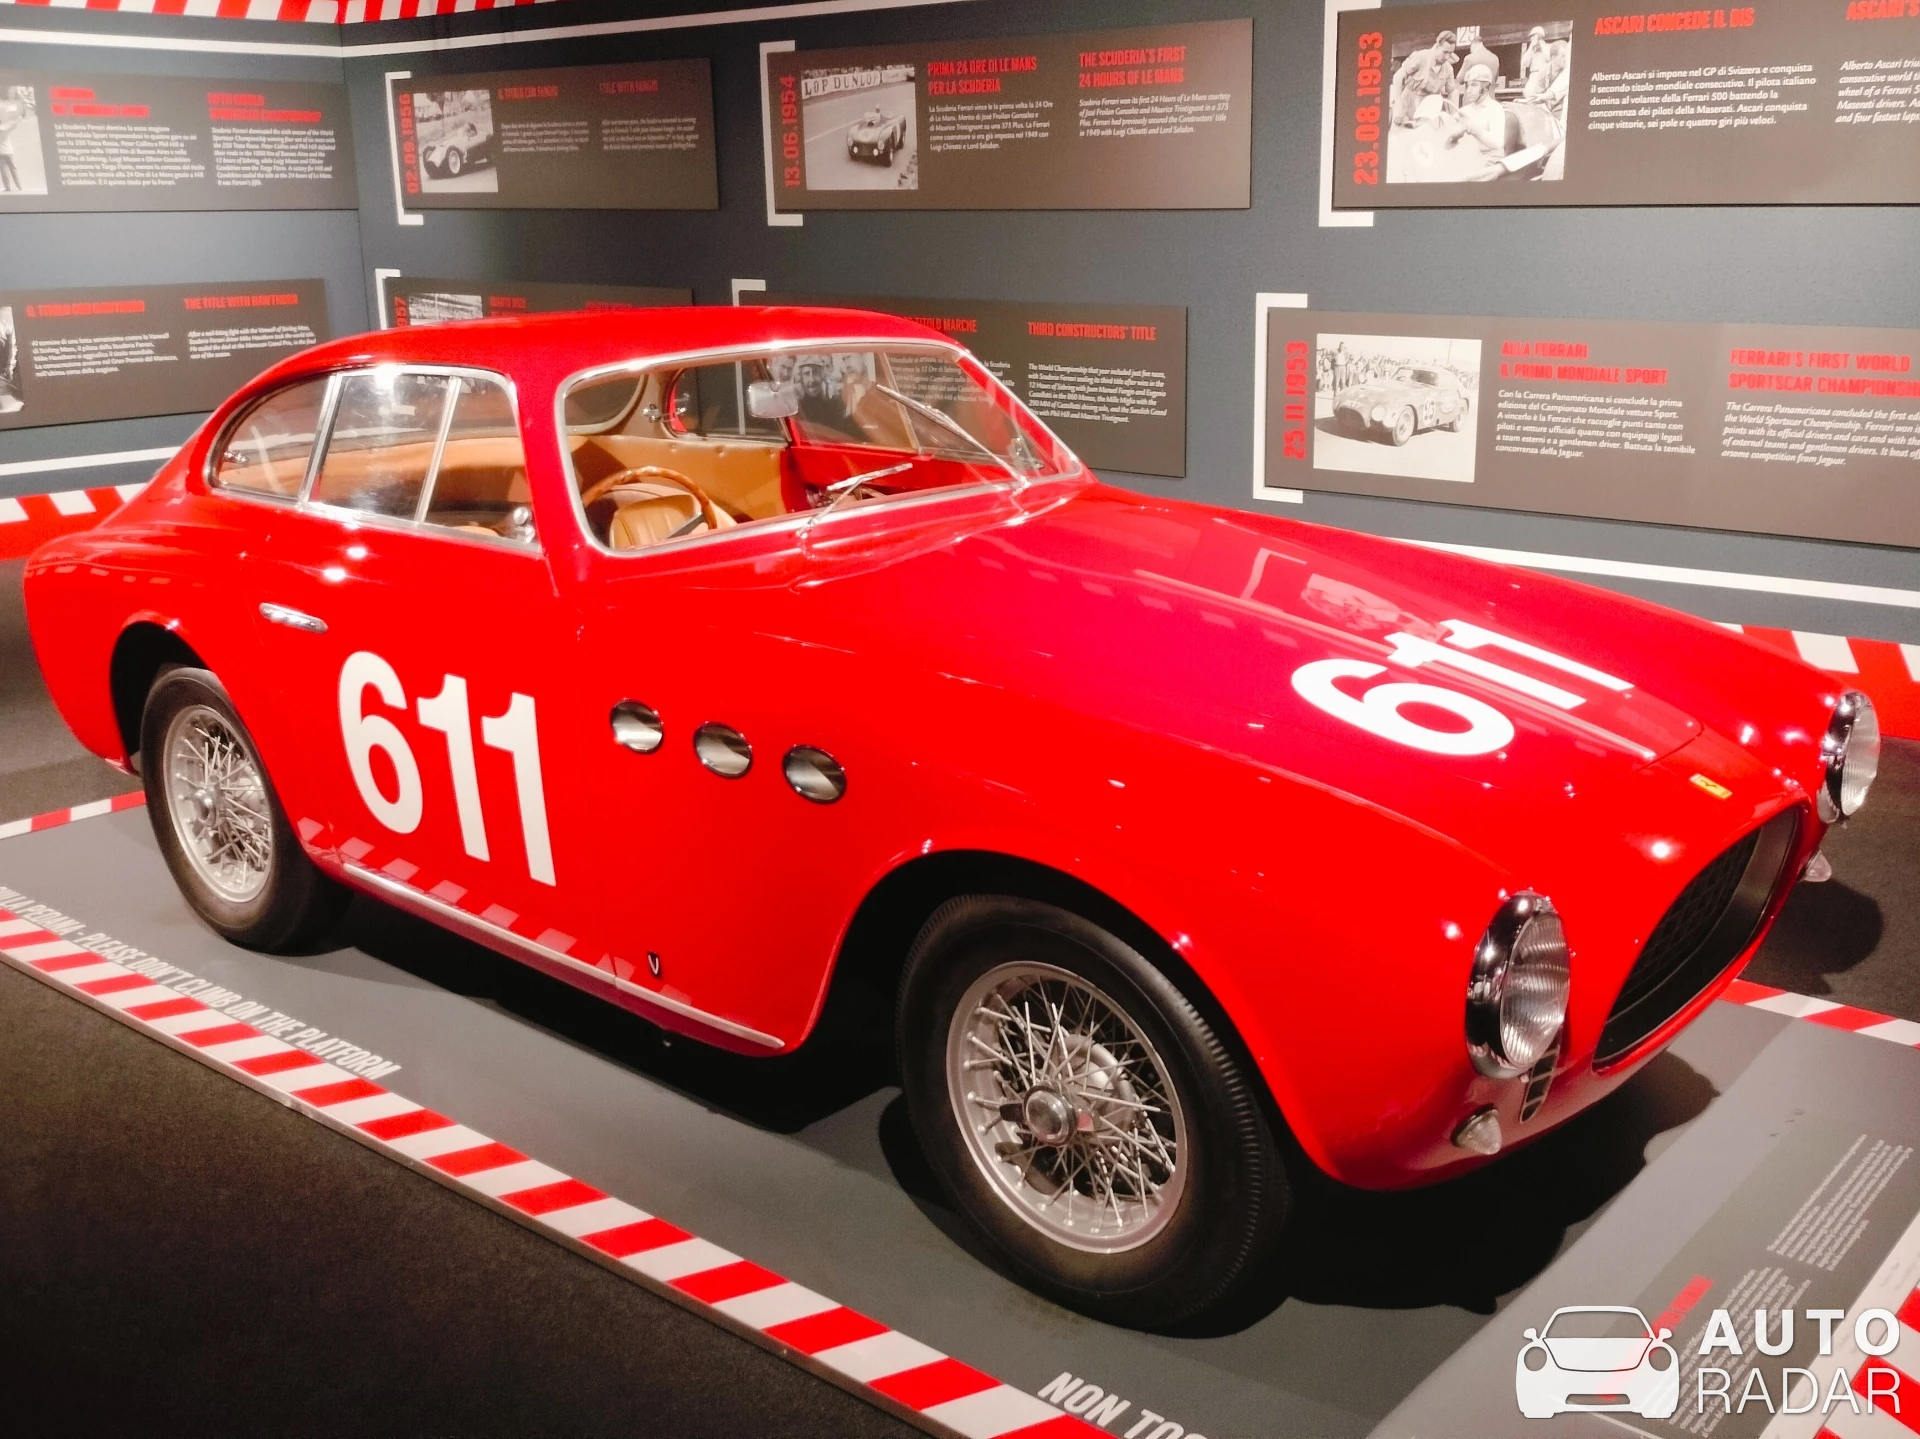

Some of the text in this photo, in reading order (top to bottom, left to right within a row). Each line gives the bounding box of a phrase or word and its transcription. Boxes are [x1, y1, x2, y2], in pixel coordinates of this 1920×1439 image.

[1846, 1, 1920, 20] ASCARI'S
[1595, 8, 1754, 34] ASCARI CONCEDE IL BIS
[928, 56, 1036, 76] PRIMA 24 ORE DI LE MANS
[1080, 47, 1184, 67] THE SCUDERIA'S FIRST
[1079, 68, 1183, 86] 24 HOURS OF LE MANS
[1591, 72, 1621, 81] Alberto
[1621, 70, 1646, 79] Ascari
[1647, 70, 1655, 79] si
[1656, 70, 1687, 80] impone
[1688, 67, 1701, 76] nel
[1702, 67, 1717, 76] GP
[1717, 66, 1726, 75] di
[1727, 66, 1761, 75] Svizzera
[1768, 63, 1813, 74] conquista
[834, 74, 878, 89] DUNLOP
[929, 78, 1001, 94] PER LA SCUDERIA
[1590, 76, 1816, 93] il secondo titolo mondiale consecutivo. Il pilota italiano
[1589, 89, 1778, 105] domina al volante della Ferrari 500 battendo la
[1354, 32, 1383, 184] 23.08.1953
[1588, 102, 1807, 117] concorrenza dei piloti della Maserati. Ascari conquista
[780, 75, 800, 187] 13.06.1954
[1587, 121, 1614, 131] cinque
[1615, 120, 1646, 128] vittorie,
[1647, 119, 1658, 127] sei
[1659, 118, 1678, 129] pole
[1685, 119, 1718, 128] quattro
[1717, 116, 1733, 128] giri
[1733, 116, 1748, 127] più
[1749, 115, 1776, 124] veloci.
[399, 93, 419, 193] 02.09.1956
[943, 320, 977, 332] MARCHE
[1028, 322, 1155, 340] THIRD CONSTRUCTORS' TITLE
[1501, 342, 1588, 358] ALLA FERRARI
[1730, 349, 1911, 372] FERRARI'S FIRST WORLD
[1500, 363, 1667, 384] IL PRIMO MONDIALE SPORT
[1729, 373, 1813, 391] SPORTSCAR
[1284, 341, 1309, 460] 25.11.1953
[1498, 389, 1682, 408] Con la Carrera Panamericana si conclude la prima
[1497, 401, 1527, 409] edizione
[1527, 402, 1539, 410] del
[1540, 403, 1587, 413] Campionato
[1588, 406, 1625, 415] Mondiale
[1653, 409, 1678, 419] Sport.
[1504, 412, 1532, 420] vincerlo
[1538, 413, 1546, 421] la
[1547, 414, 1571, 422] Ferrari
[1572, 415, 1586, 424] che
[1587, 418, 1621, 428] raccoglie
[1622, 420, 1643, 428] punti
[1644, 421, 1666, 429] tanto
[1496, 422, 1515, 431] piloti
[1548, 425, 1575, 434] ufficiali
[1576, 429, 1605, 437] quanto
[1621, 431, 1659, 442] equipaggi
[1660, 432, 1682, 443] legati
[1495, 445, 1583, 458] concorrenza della Jaguar.
[1558, 438, 1597, 447] gentlemen
[1598, 440, 1622, 448] driver.
[1623, 441, 1653, 451] Battuta
[1654, 443, 1662, 451] la
[1663, 445, 1695, 453] temibile
[1291, 619, 1635, 755] 611
[337, 651, 556, 887] 611
[73, 932, 148, 964] PLEASE
[129, 956, 195, 985] DON'T
[173, 978, 242, 1008] CLIMB
[223, 1001, 270, 1020] ON
[252, 1011, 306, 1037] THE
[284, 1027, 401, 1080] PLATFORM
[1037, 1371, 1207, 1439] NON TO
